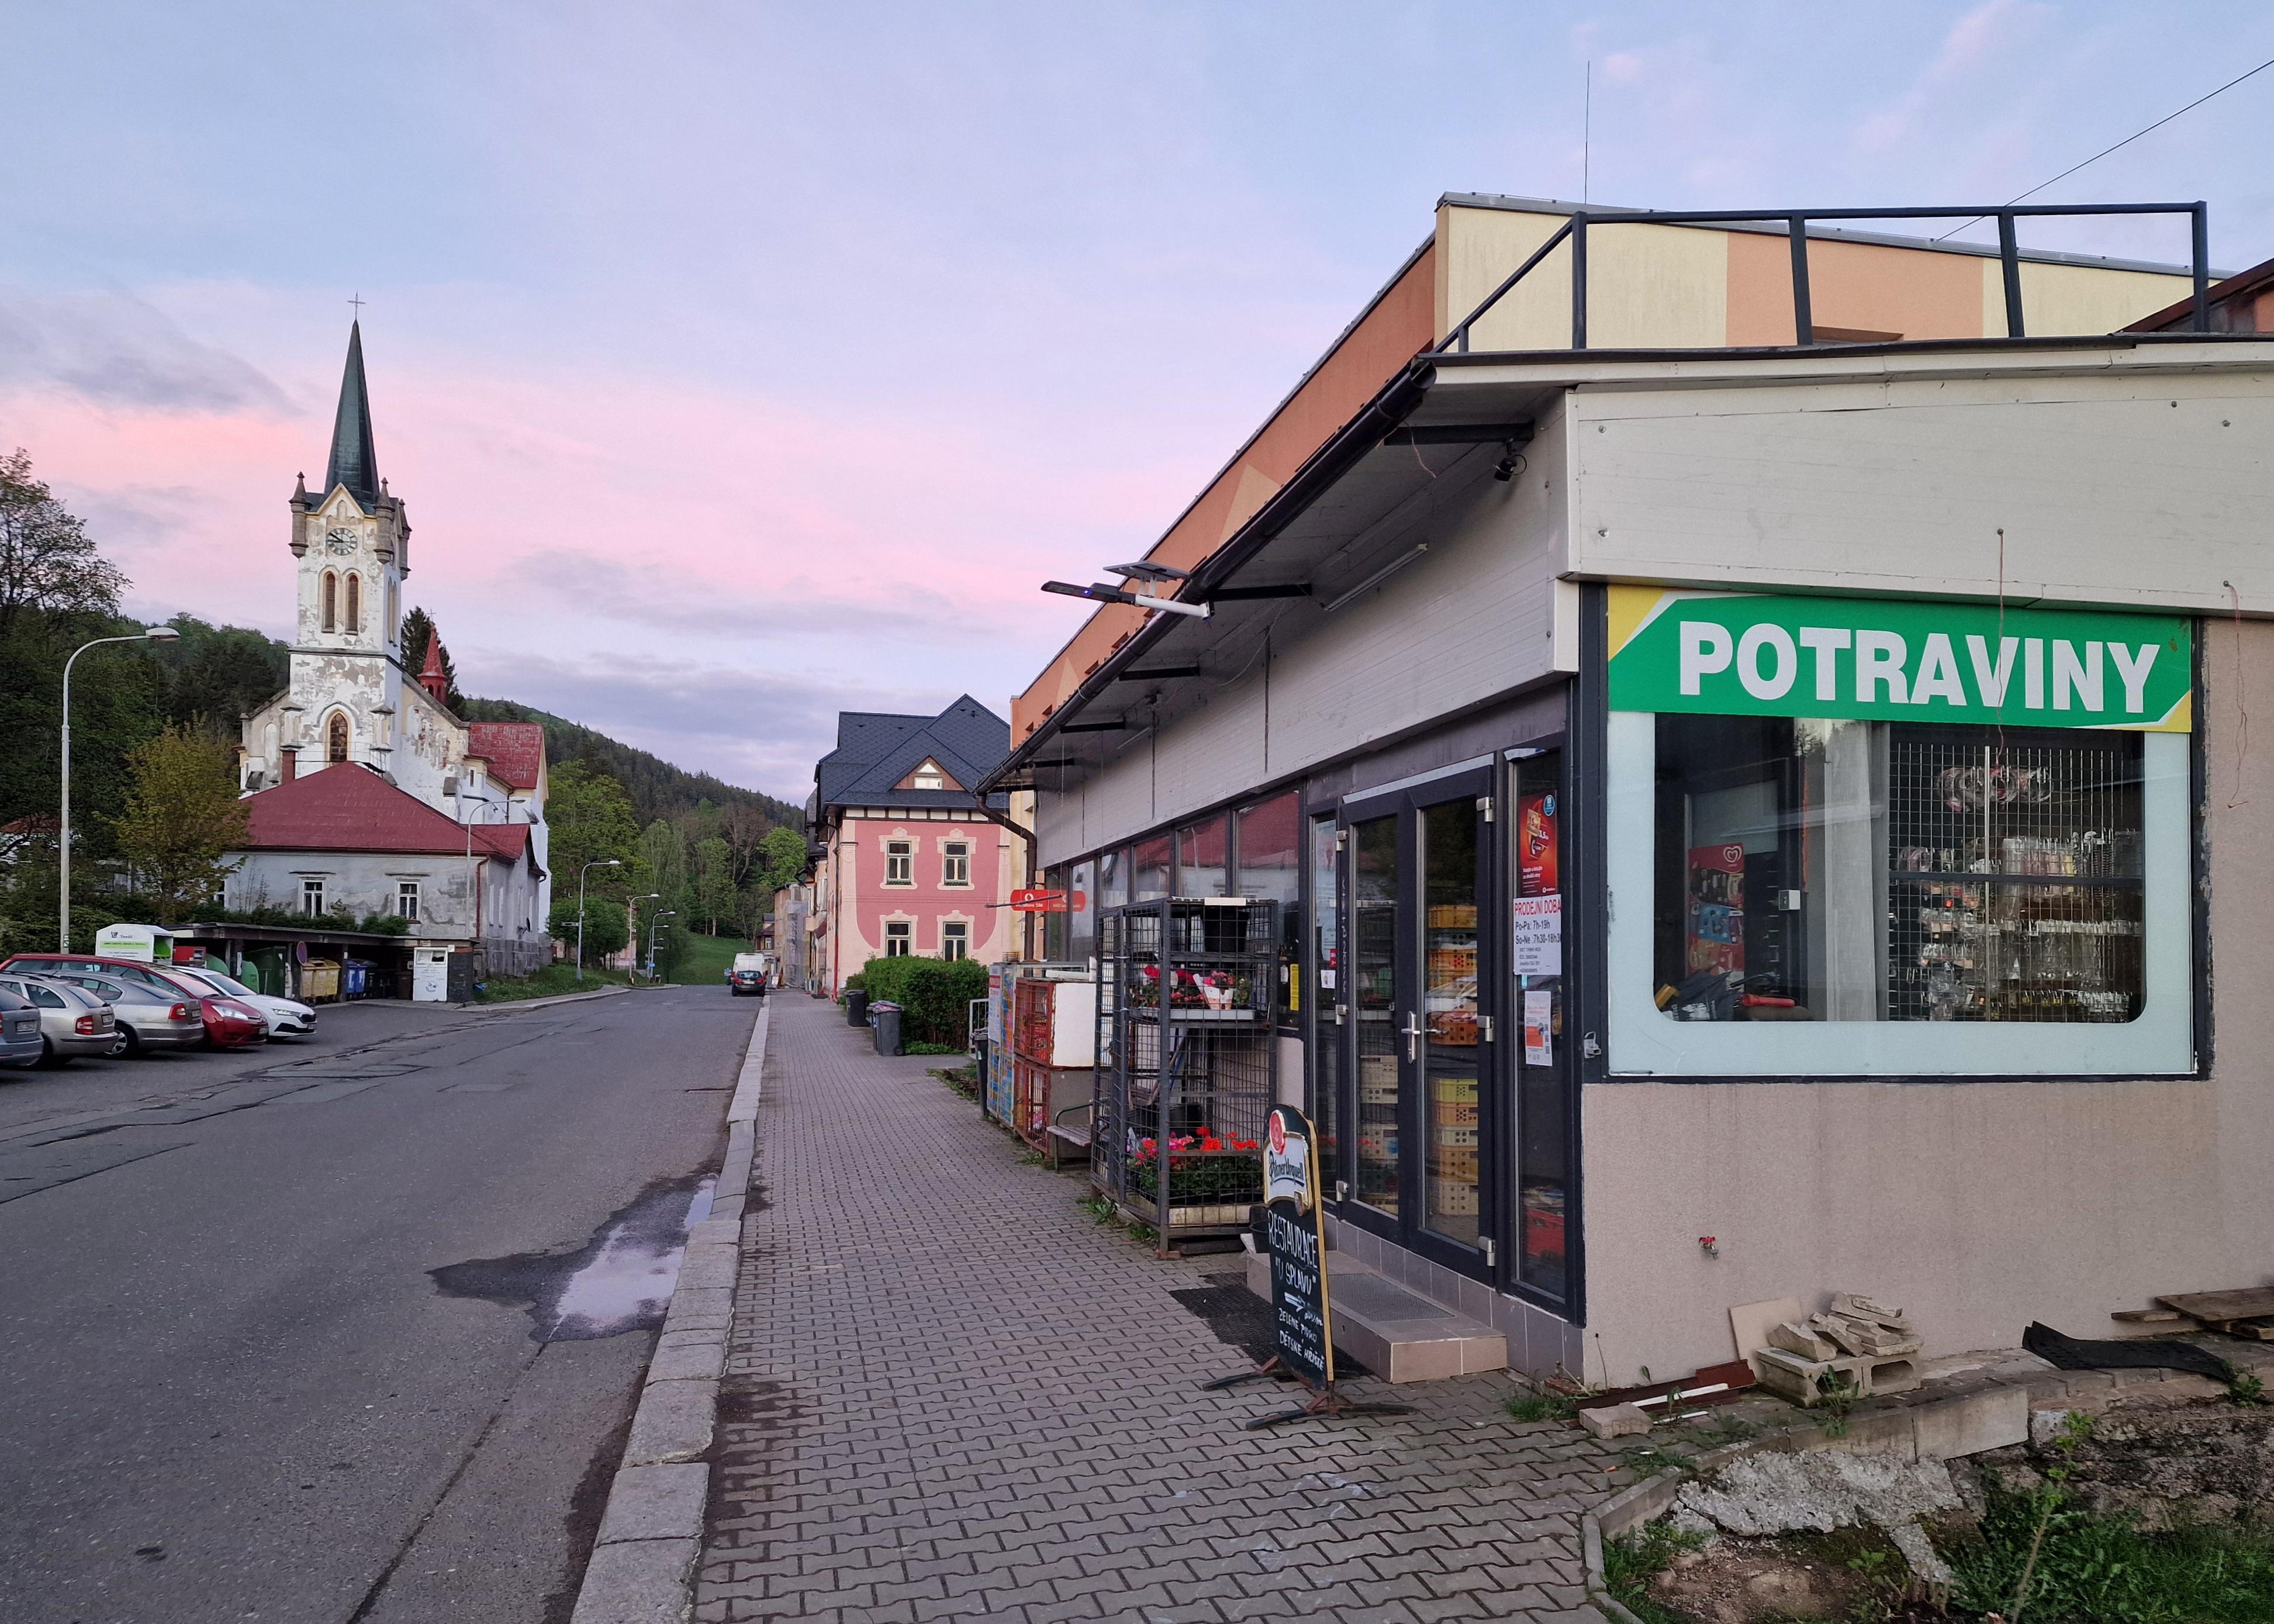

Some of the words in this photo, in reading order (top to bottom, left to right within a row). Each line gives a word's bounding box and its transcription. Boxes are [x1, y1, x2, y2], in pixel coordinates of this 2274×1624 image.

[1679, 620, 2161, 714] POTRAVINY
[1544, 899, 1562, 914] DOBA
[1269, 1150, 1285, 1186] Pilsner
[1284, 1154, 1304, 1185] Urquell
[1267, 1209, 1318, 1269] RESTAURACE
[1300, 1323, 1317, 1343] PIVKO
